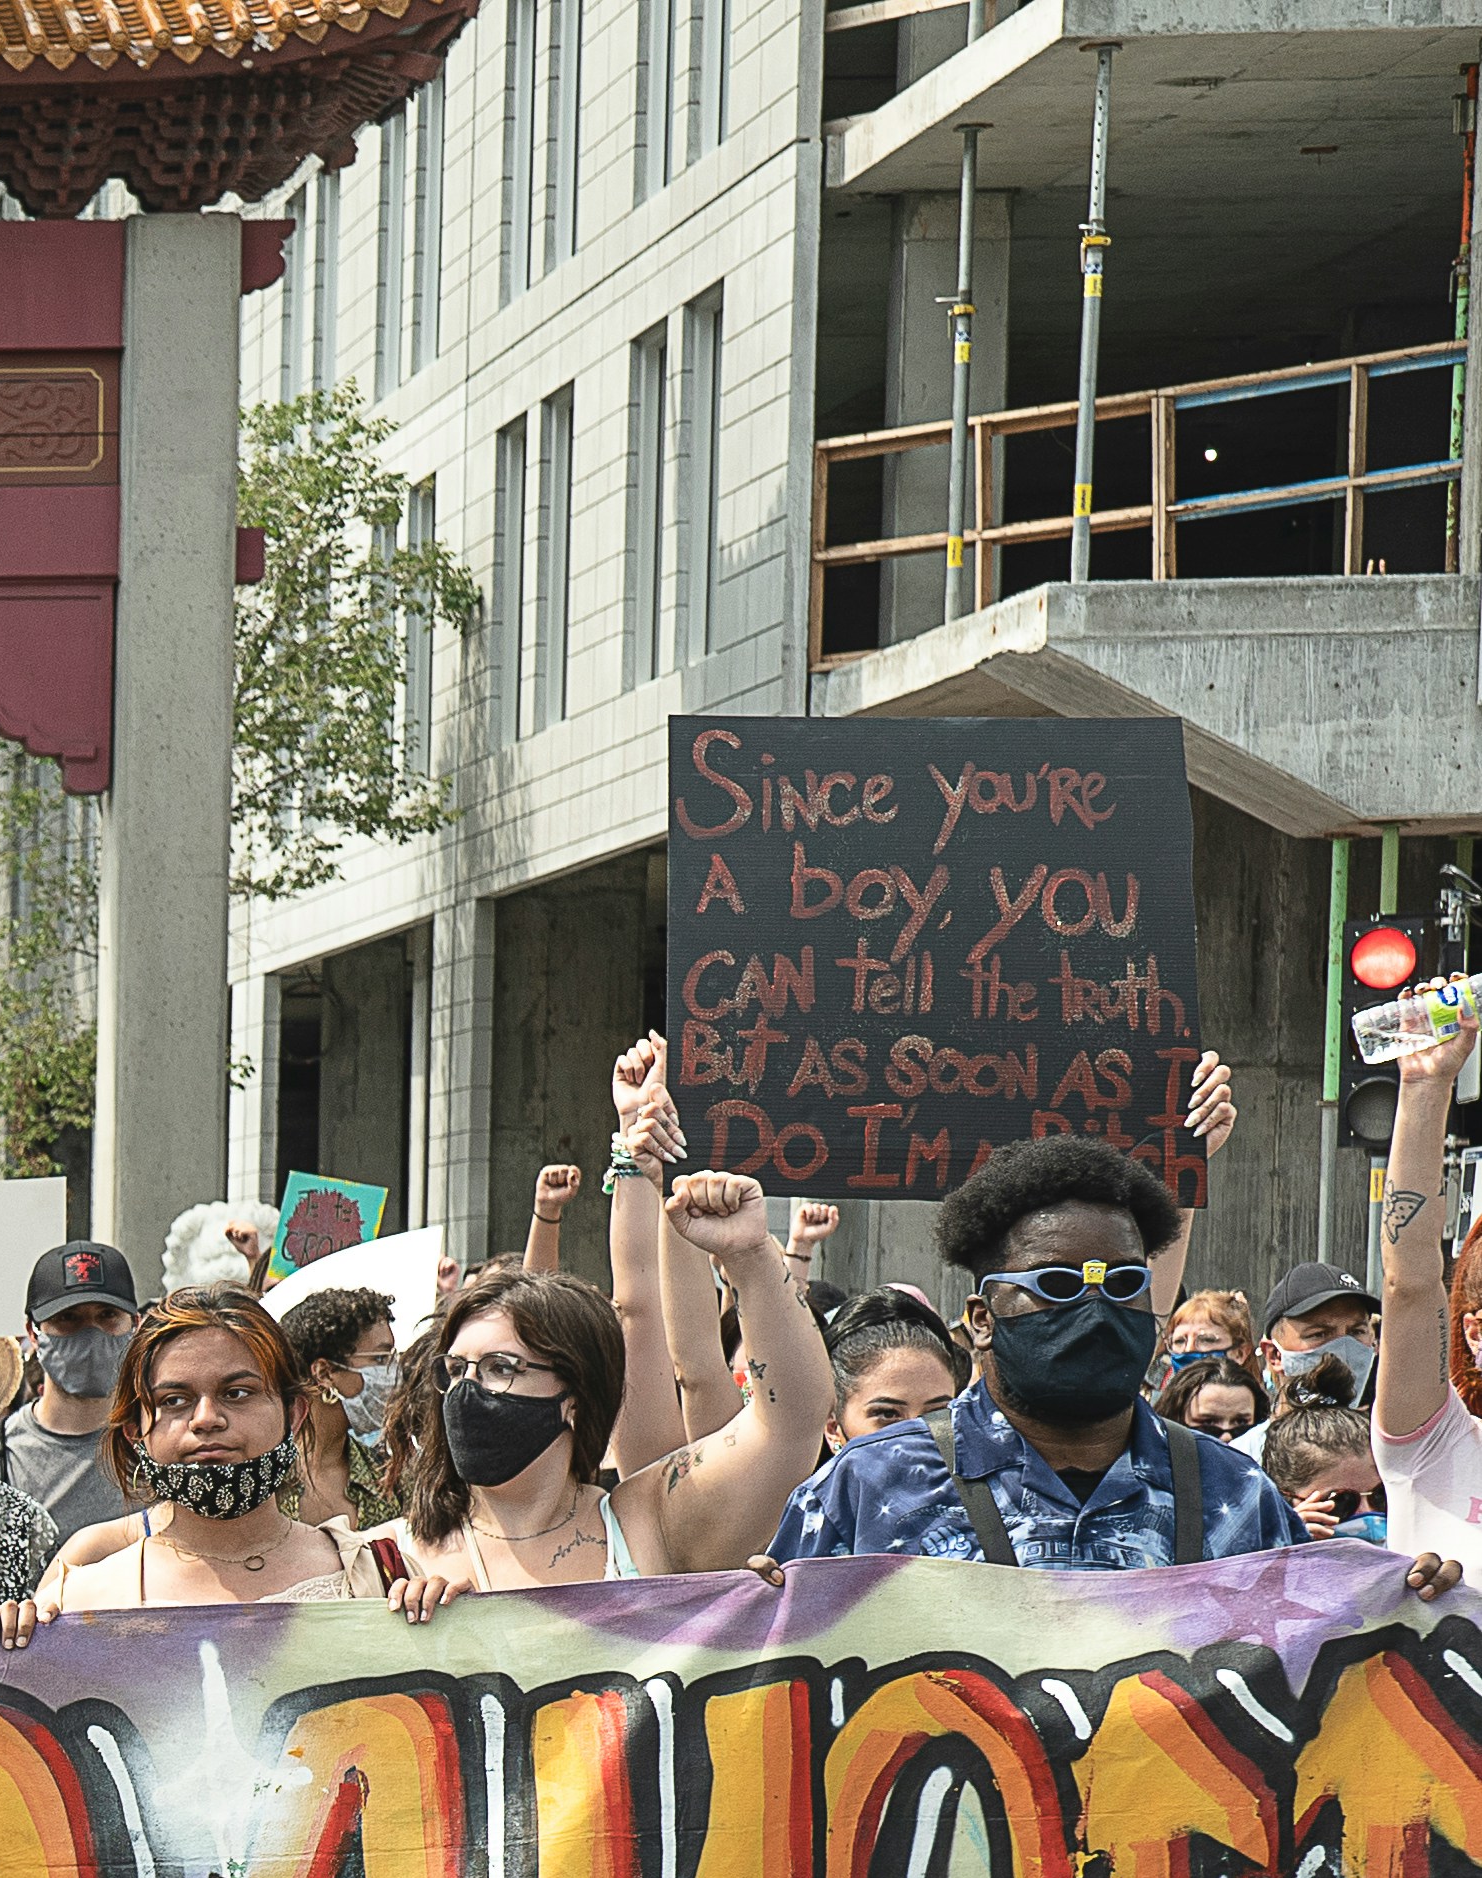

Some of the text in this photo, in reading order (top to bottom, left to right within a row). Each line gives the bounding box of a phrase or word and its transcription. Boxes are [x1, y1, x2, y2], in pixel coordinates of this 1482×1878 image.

[696, 853, 745, 915] A
[682, 945, 816, 1020] CAN
[787, 1036, 869, 1099] AS
[1050, 1049, 1133, 1111] AS
[1146, 1047, 1200, 1129] I
[282, 1231, 360, 1267] CRO
